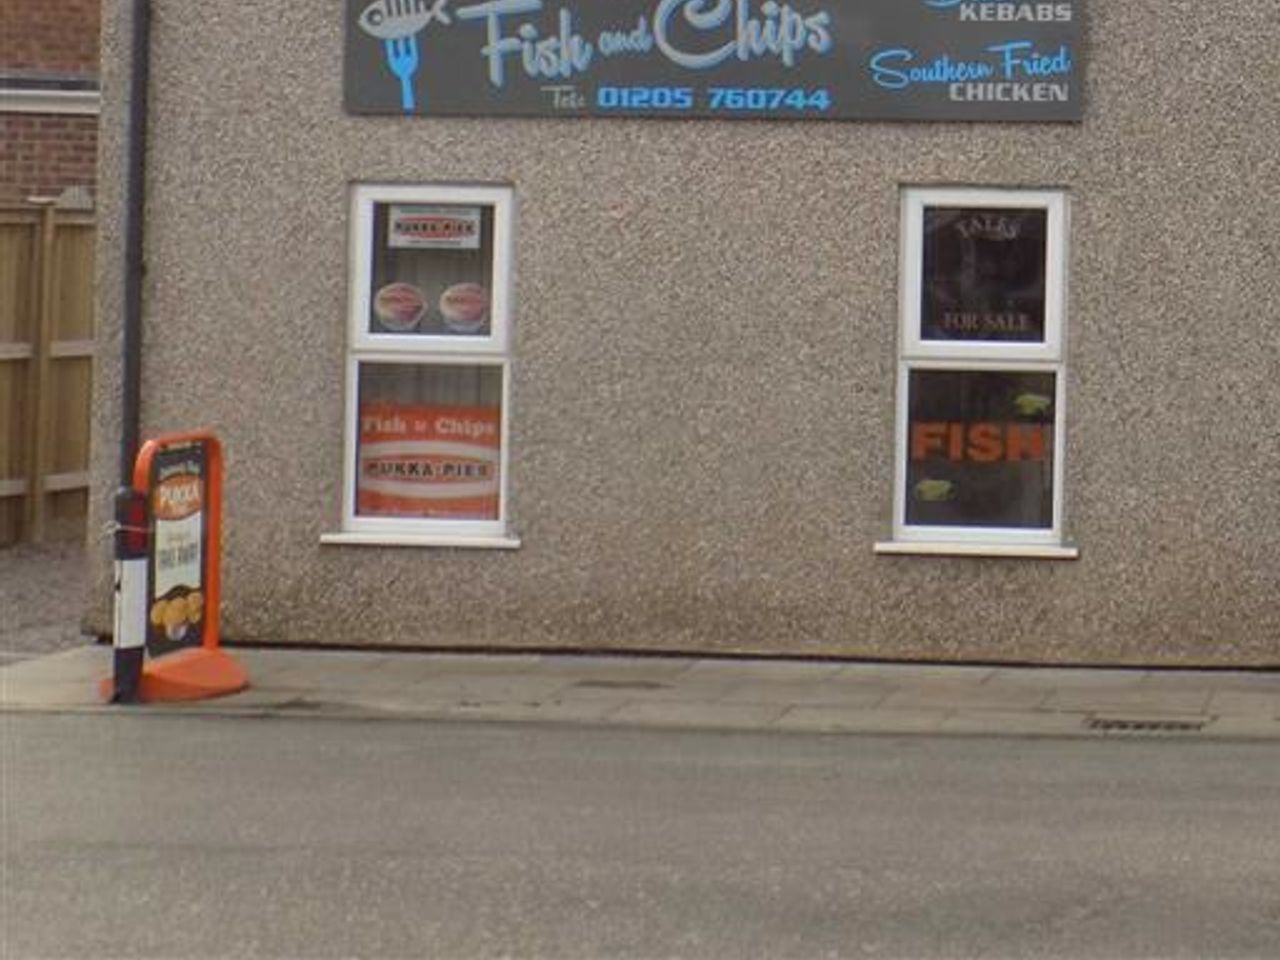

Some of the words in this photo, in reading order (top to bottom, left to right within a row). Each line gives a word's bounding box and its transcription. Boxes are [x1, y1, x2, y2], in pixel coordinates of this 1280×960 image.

[960, 3, 1071, 21] KEBABS
[598, 15, 654, 56] and
[870, 50, 994, 88] Southern
[985, 41, 1072, 80] Fried
[597, 87, 694, 109] 01205
[709, 87, 831, 111] 760744
[950, 82, 1068, 102] CHICKEN
[434, 416, 497, 440] Chips
[913, 420, 1042, 462] FISH
